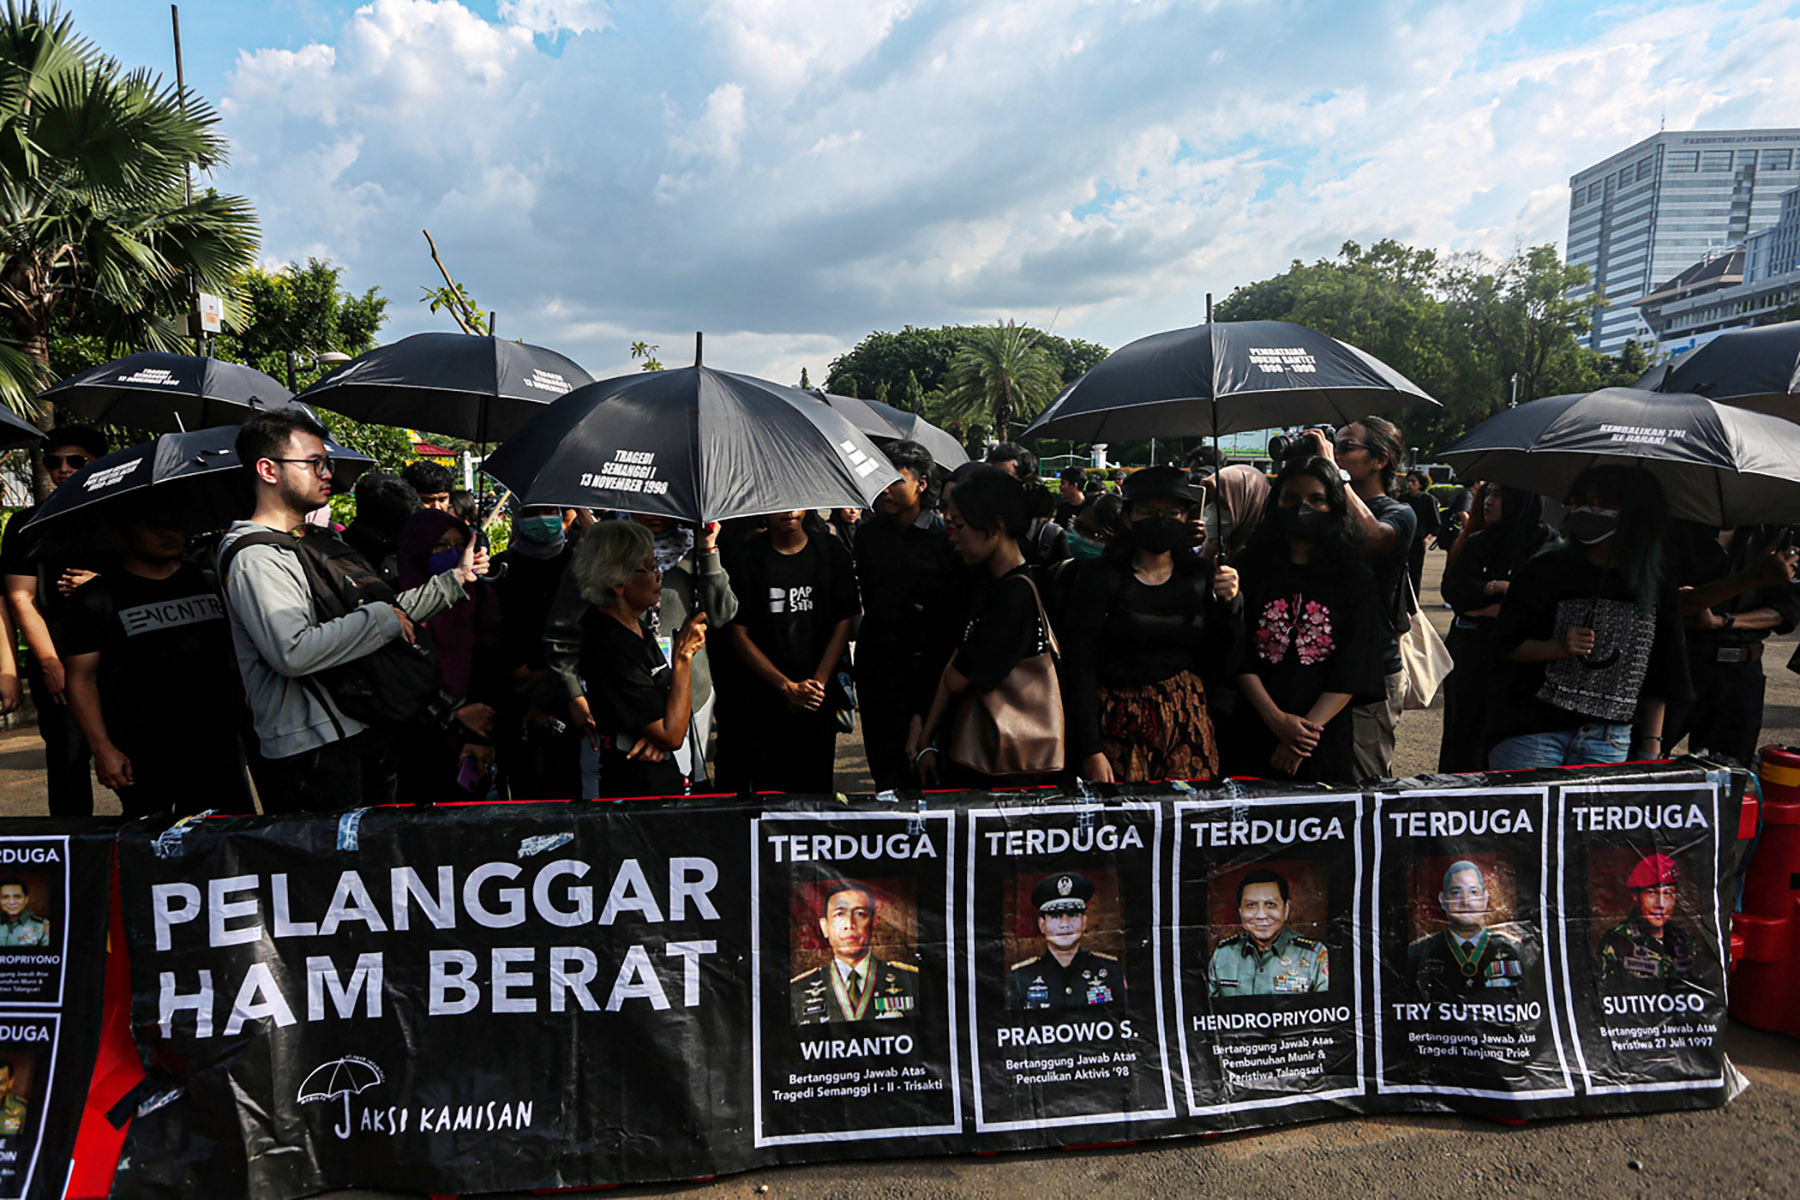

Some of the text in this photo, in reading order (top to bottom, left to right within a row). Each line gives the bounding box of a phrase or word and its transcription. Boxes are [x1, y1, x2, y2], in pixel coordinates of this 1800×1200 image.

[1600, 424, 1666, 437] KEMBALIKAN
[1611, 434, 1626, 442] KE
[614, 449, 655, 465] TRAGEDI
[601, 462, 657, 479] SEMANGGI I
[580, 473, 669, 495] 13 NOVEMBER 1998
[1389, 809, 1534, 838] TERDUGA
[1572, 803, 1709, 831] TERDUGA
[984, 825, 1144, 856] TERDUGA
[1190, 817, 1346, 847] TERDUGA
[0, 848, 60, 863] DUGA
[768, 833, 938, 863] TERDUGA
[152, 856, 721, 951] PELANGGAR
[158, 940, 717, 1039] HAM BERAT
[1392, 1001, 1541, 1022] TRY SUTRISNO
[1603, 994, 1705, 1015] SUTIYOSO
[1193, 1006, 1350, 1031] HENDROPRIYONO
[997, 1019, 1139, 1048] PRABOWO S.
[1408, 1032, 1536, 1045] Bertanggung Jawab Atas
[1600, 1023, 1717, 1038] Bertanggung Jawab Atas
[800, 1034, 913, 1061] WIRANTO
[1212, 1036, 1334, 1055] Bertanggung Jawab Atas
[1418, 1045, 1531, 1060] Tragedi Tanjung Priok
[1612, 1036, 1713, 1050] Peristiwa 27 Juli 1997
[1005, 1051, 1137, 1071] Bertanggung Jawab Atas
[1222, 1049, 1326, 1069] Pembunuhan Munir &
[788, 1066, 926, 1086] Bertanggung Jawab Atas
[1016, 1070, 1072, 1085] Penculikan
[1074, 1067, 1110, 1080] Aktivis
[1228, 1063, 1324, 1083] Peristiwa Talangsari
[772, 1086, 814, 1103] Tragedi
[816, 1081, 871, 1098] Semanggi
[872, 1082, 878, 1094] I
[903, 1078, 943, 1092] Trisakti
[361, 1101, 533, 1135] AKSI KAMISAN
